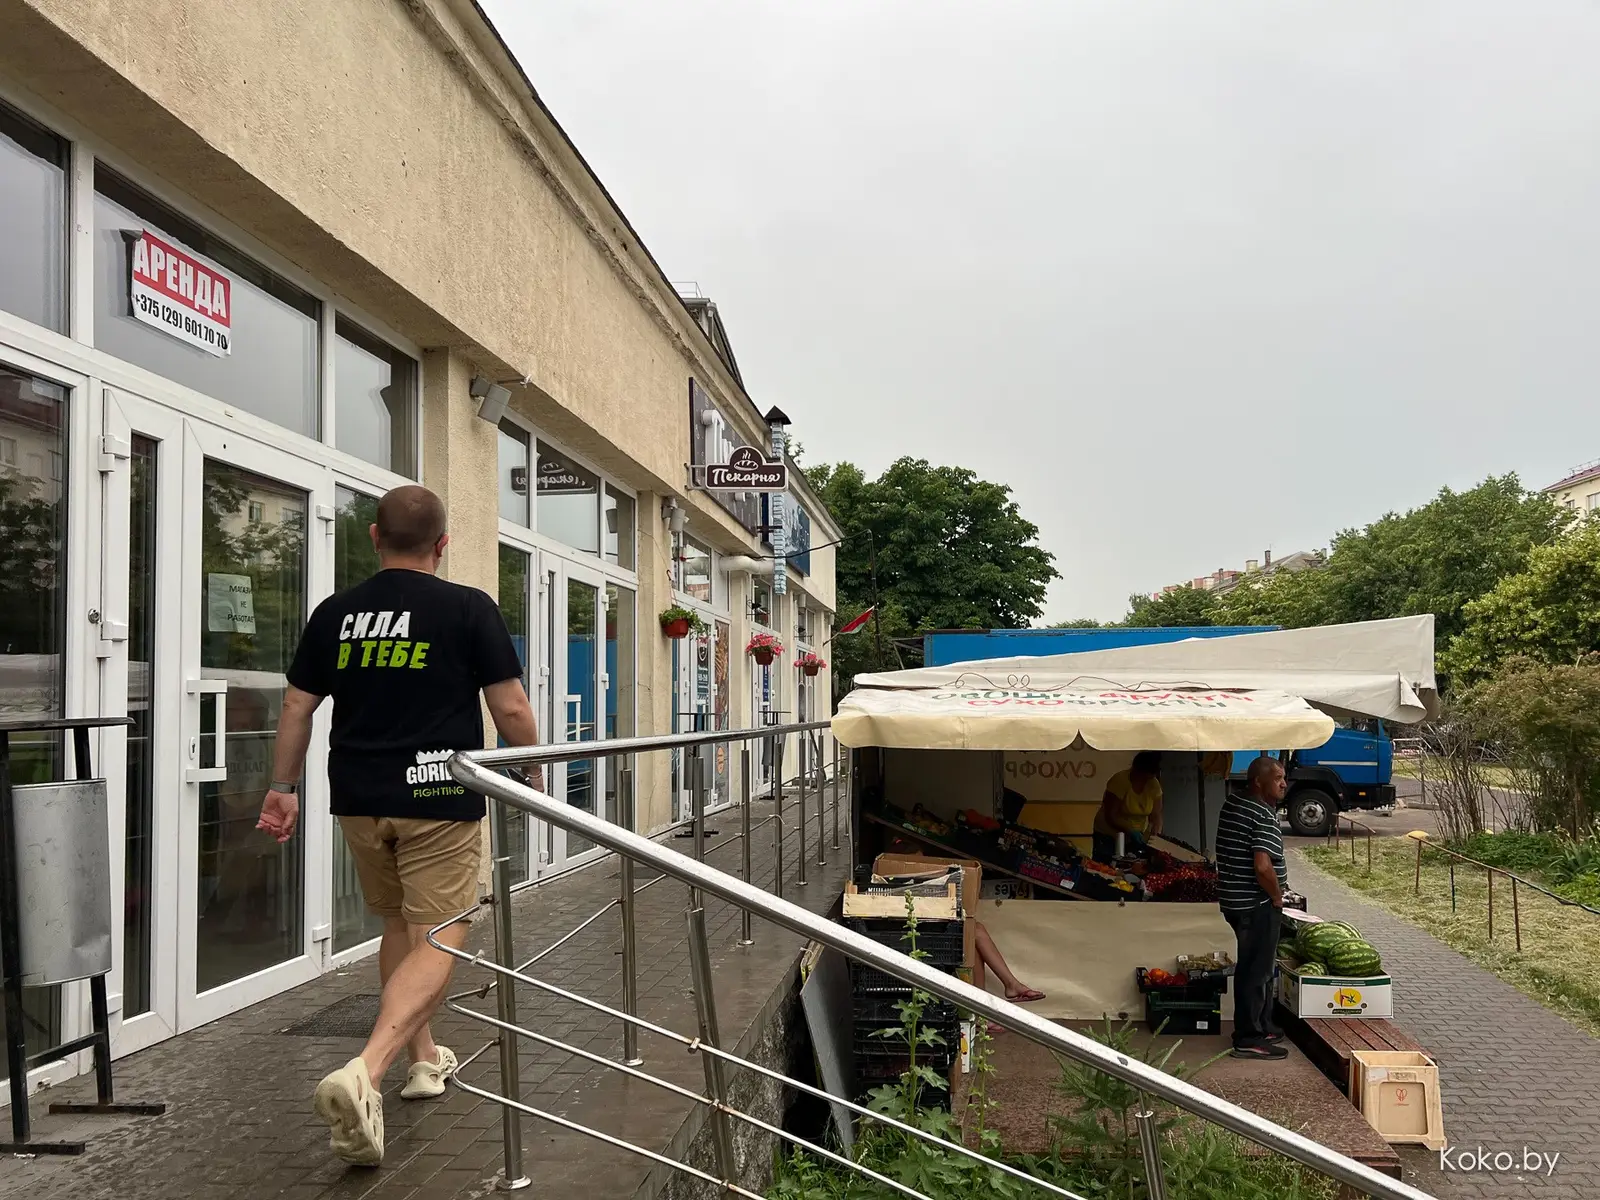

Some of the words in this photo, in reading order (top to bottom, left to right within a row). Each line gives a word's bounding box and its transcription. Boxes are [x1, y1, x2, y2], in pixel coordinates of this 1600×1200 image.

[133, 237, 227, 319] АРЕНДА
[135, 293, 160, 318] +375
[161, 305, 183, 329] (29)
[215, 331, 229, 350] 70
[711, 468, 781, 486] Пекарня
[240, 600, 247, 608] НЕ
[339, 611, 411, 641] СИЛА
[337, 642, 352, 669] В
[360, 640, 430, 669] ТЕБЕ
[412, 786, 465, 799] FIGHTING
